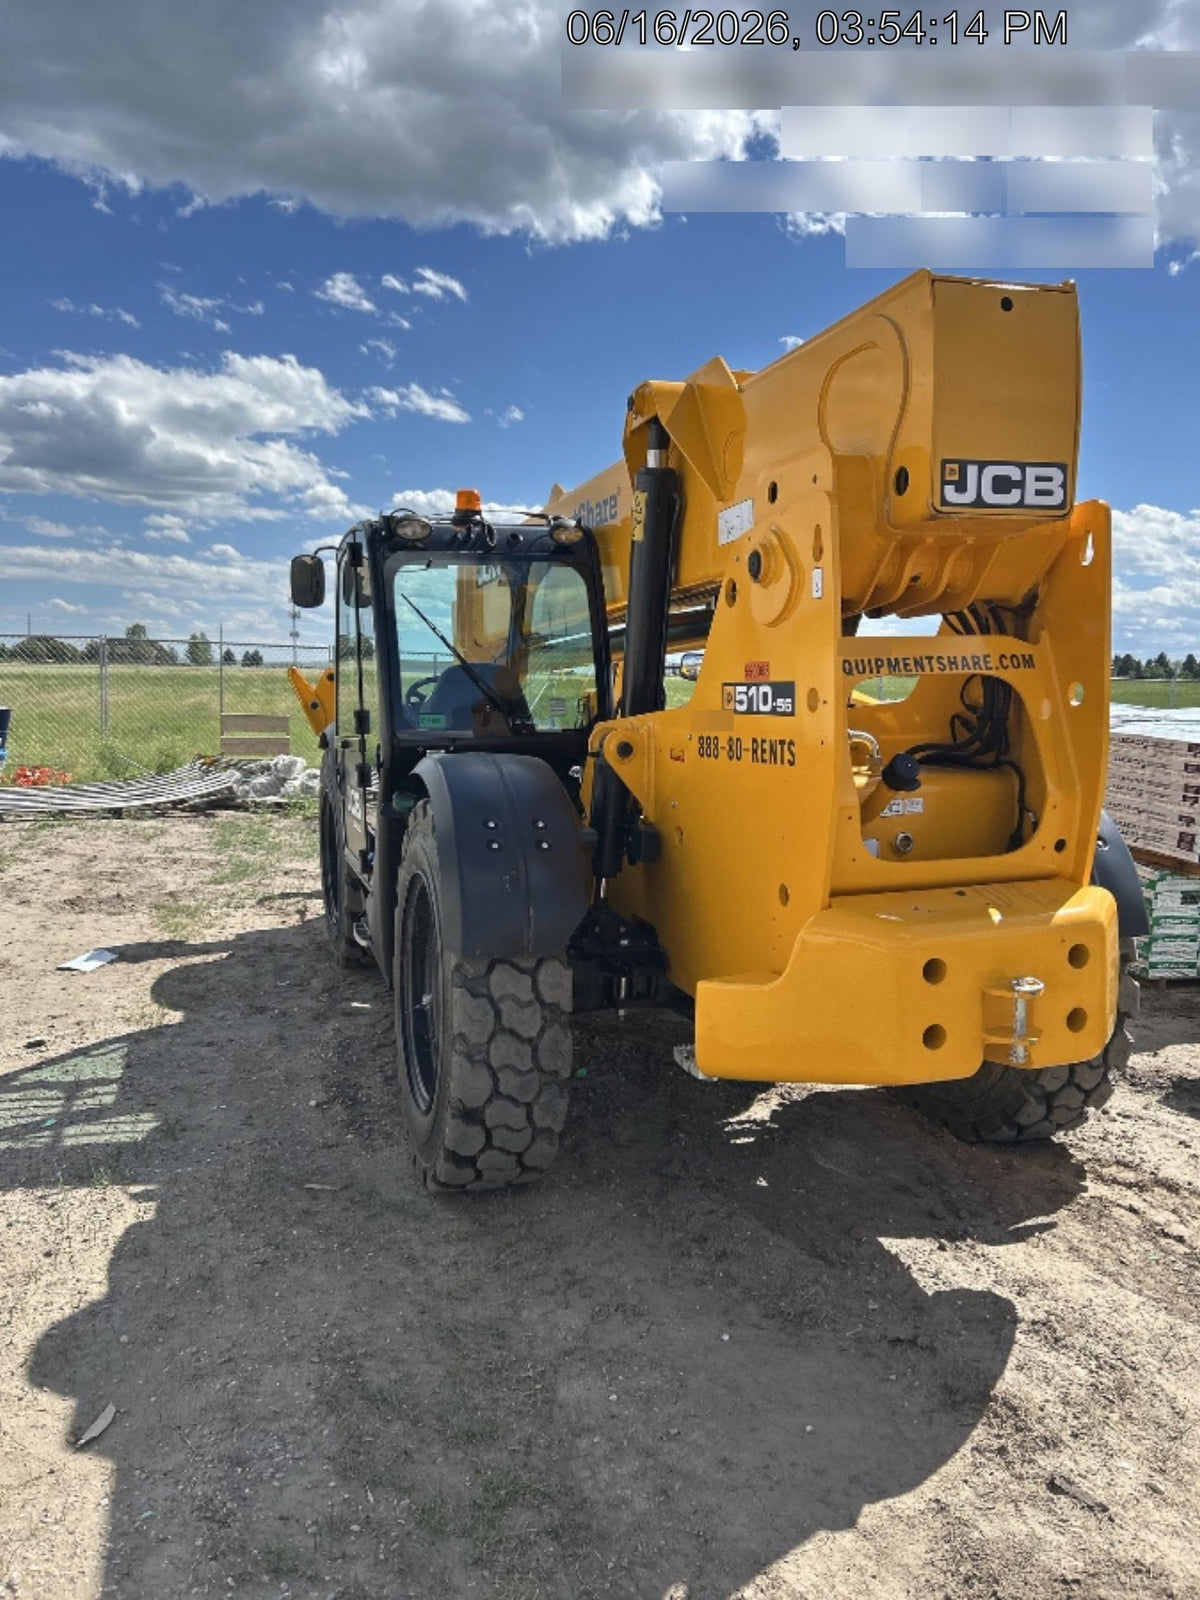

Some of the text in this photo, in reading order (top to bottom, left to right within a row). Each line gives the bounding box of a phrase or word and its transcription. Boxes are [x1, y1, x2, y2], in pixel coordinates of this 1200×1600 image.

[943, 463, 1065, 506] JCB
[841, 653, 1036, 676] QUIPMENTSHARE.COM
[697, 735, 796, 767] 888-80-RENTS
